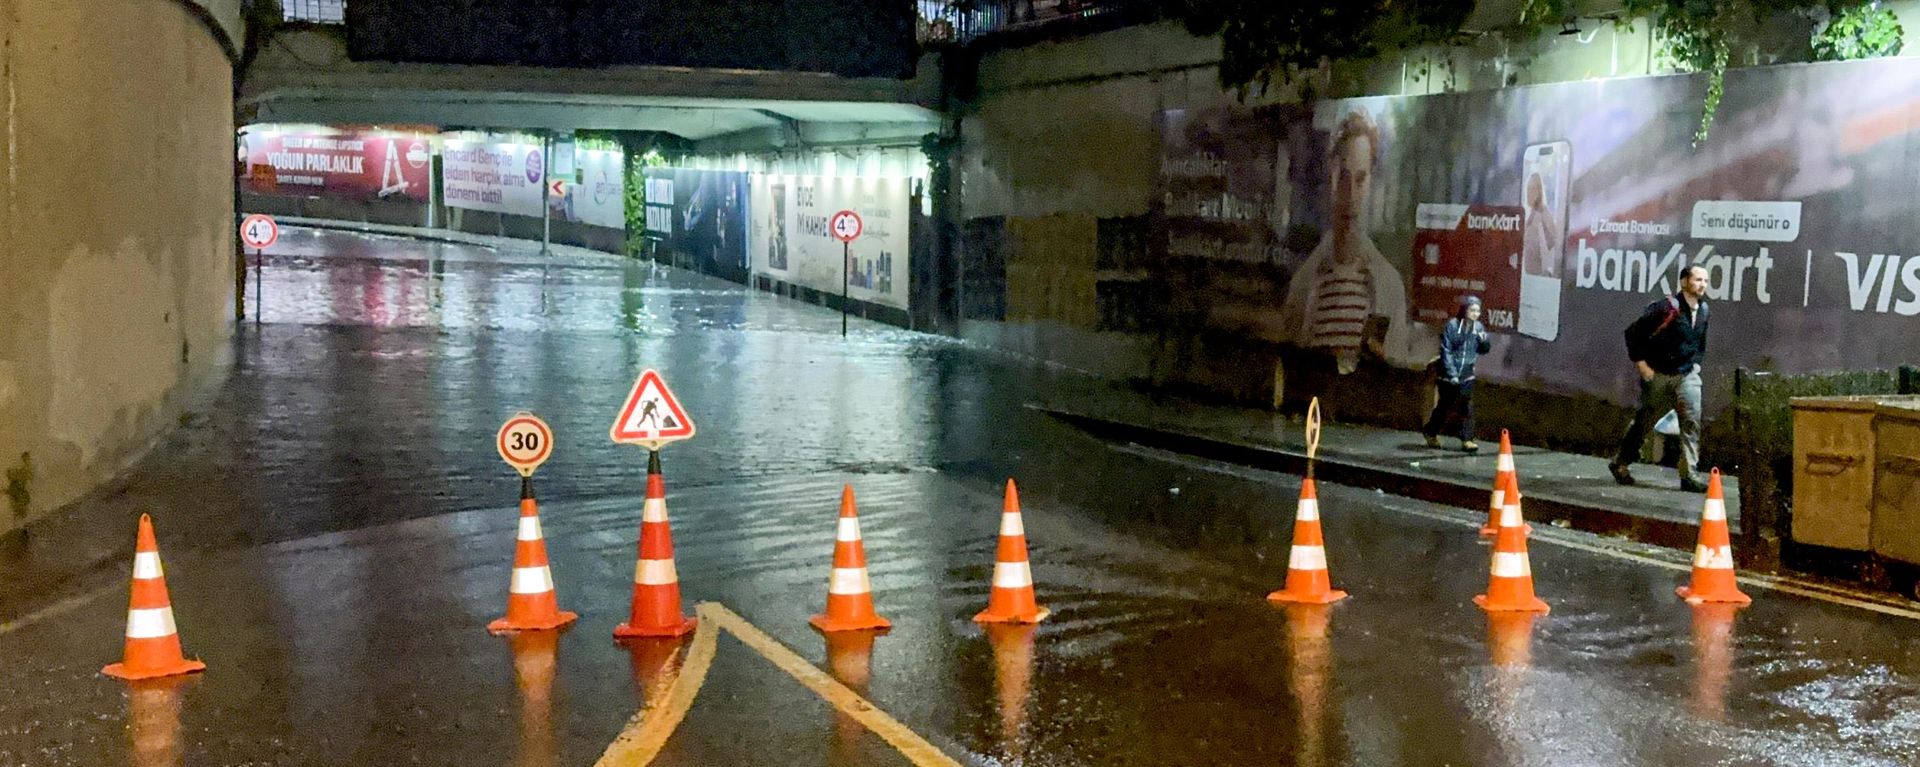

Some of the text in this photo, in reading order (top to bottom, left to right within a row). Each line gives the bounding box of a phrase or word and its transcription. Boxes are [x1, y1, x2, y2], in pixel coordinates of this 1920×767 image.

[267, 149, 365, 174] YOĞUN PARLAKLIK
[444, 145, 477, 162] Encard
[445, 165, 470, 181] elden
[502, 170, 526, 188] alma
[445, 184, 480, 200] dönemi
[248, 223, 258, 239] 4
[805, 214, 828, 238] KAHVE
[836, 218, 846, 232] 4
[1467, 212, 1521, 232] bankkart
[1599, 219, 1670, 236] Ziraat Bankası
[1700, 212, 1791, 233] Seni düşünür o
[1487, 309, 1514, 328] VISA
[510, 432, 539, 451] 30
